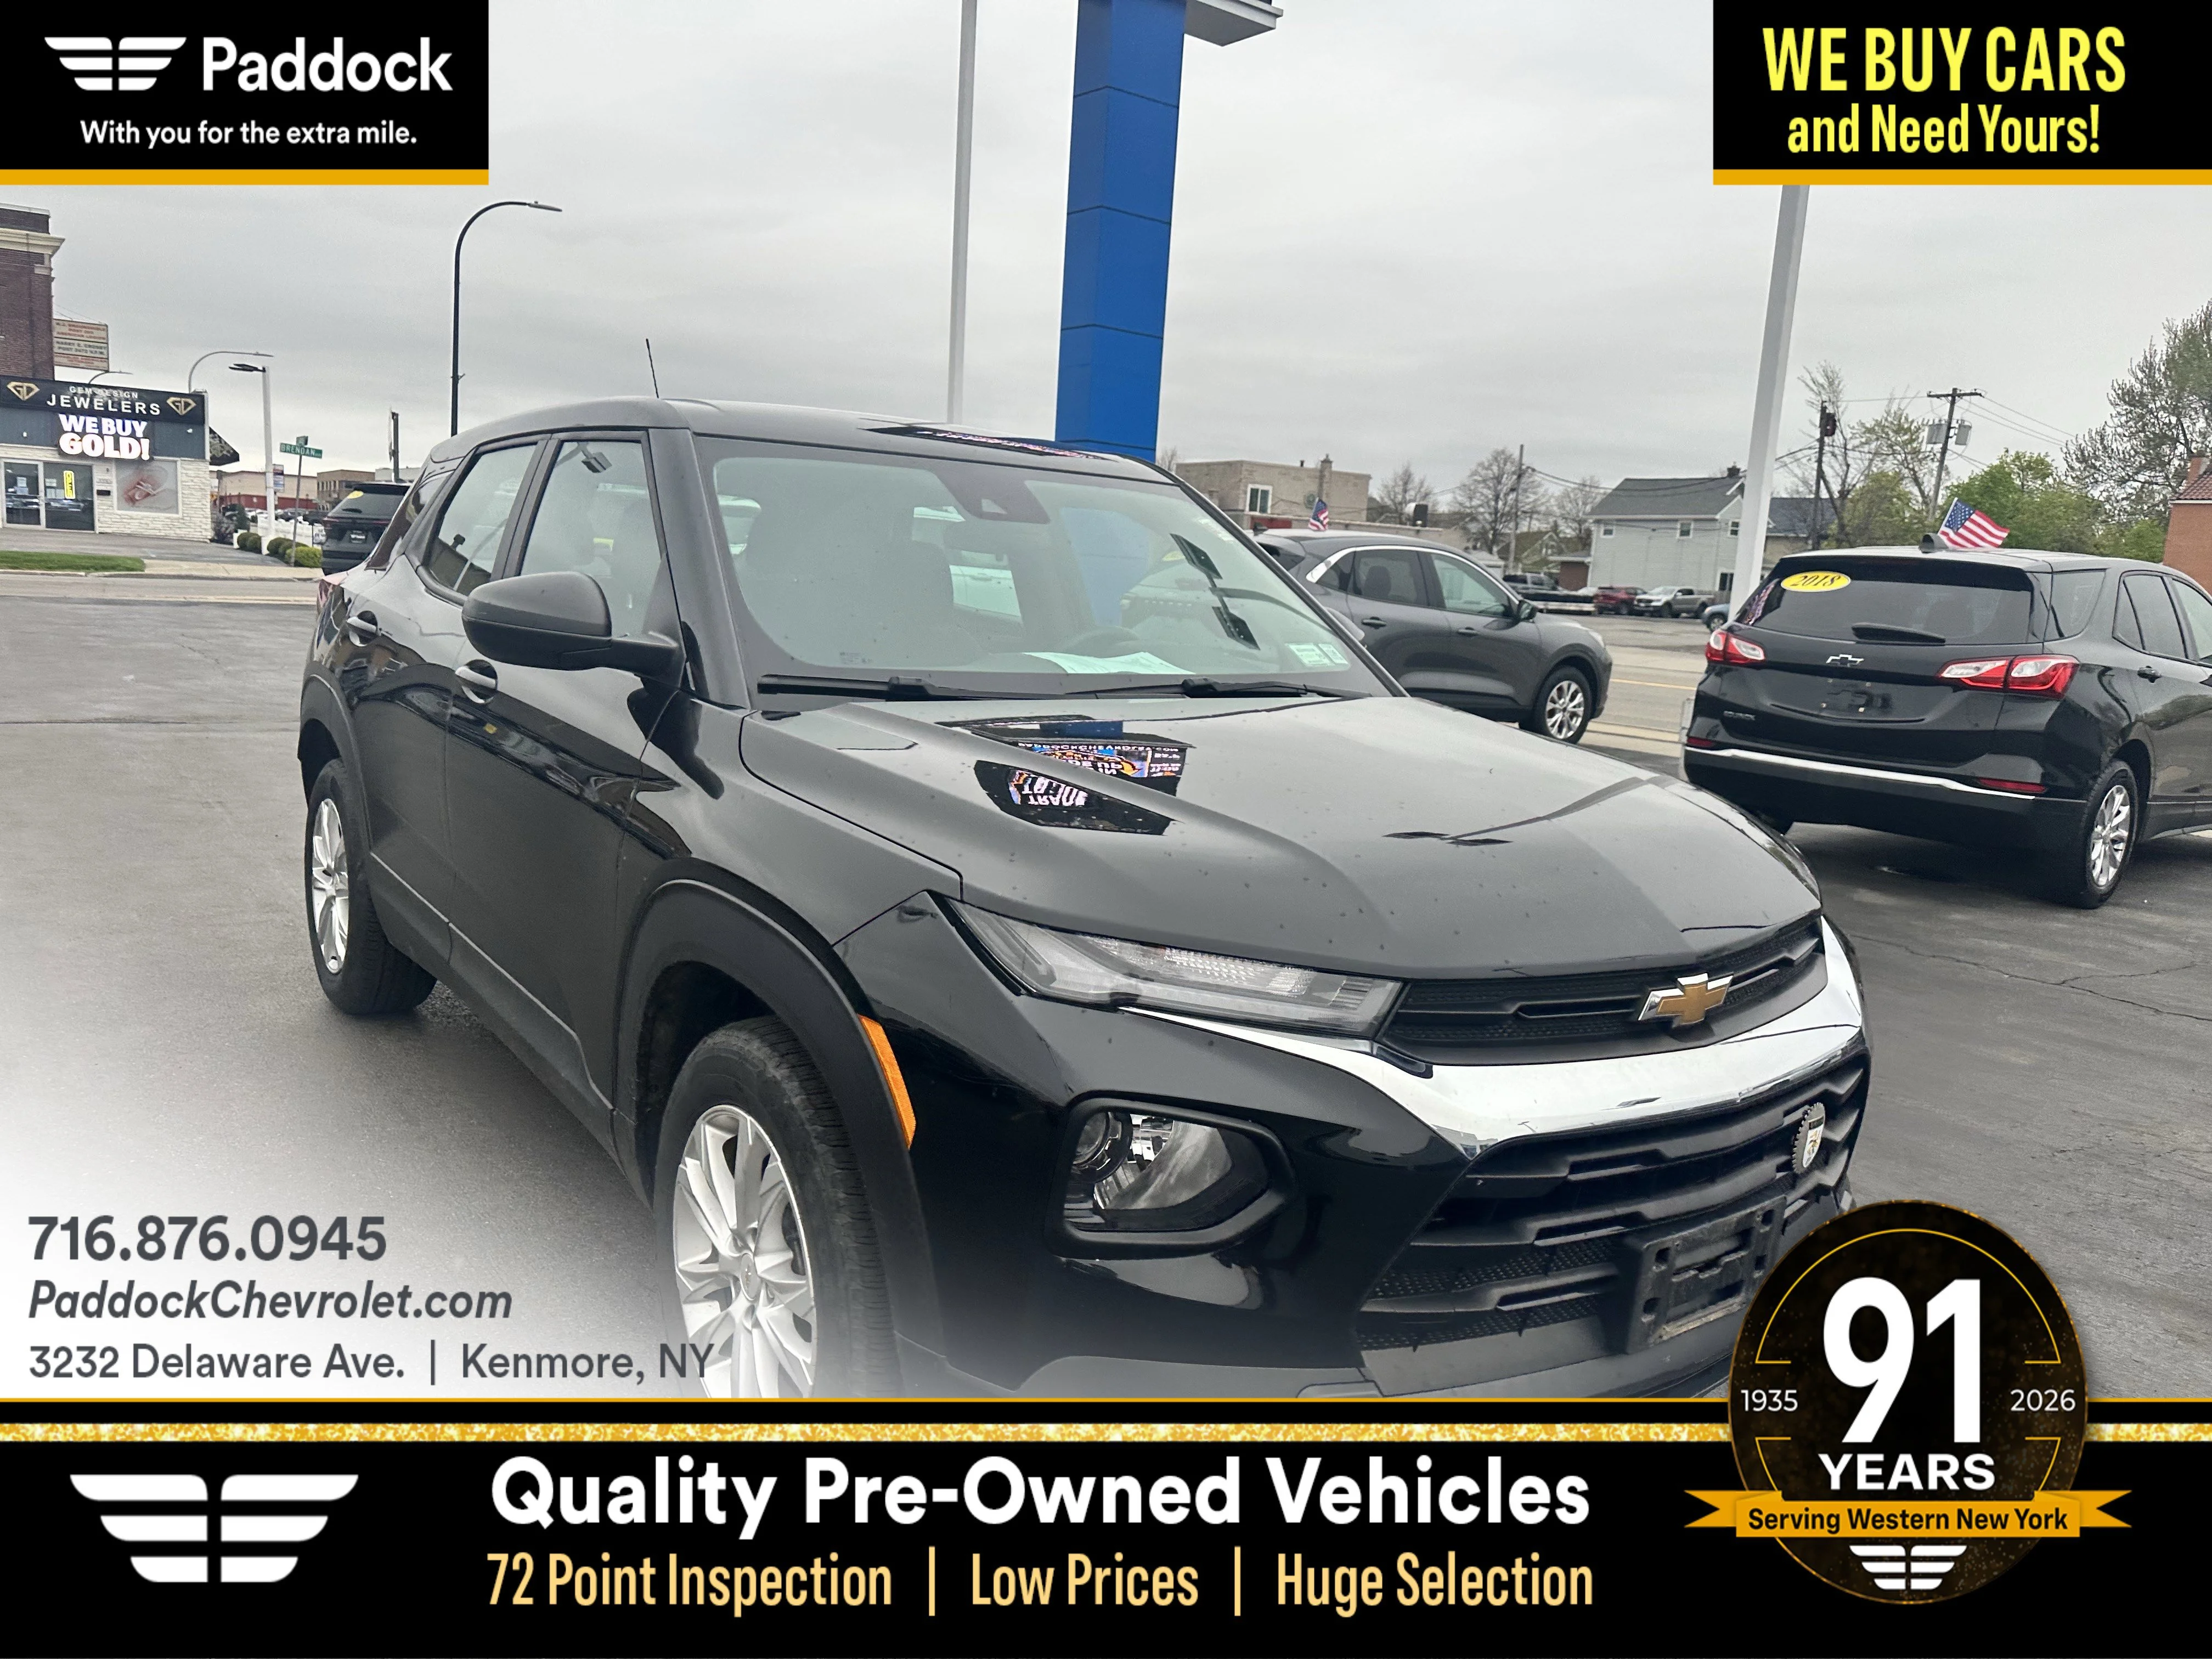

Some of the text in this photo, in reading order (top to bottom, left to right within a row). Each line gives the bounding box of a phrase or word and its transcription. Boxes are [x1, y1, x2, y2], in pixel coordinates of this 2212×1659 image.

[69, 386, 93, 396] GEM
[47, 394, 160, 415] JEWELERS
[59, 413, 148, 438] WE BUY
[59, 432, 150, 461] GOLD!
[1790, 575, 1841, 586] 2018
